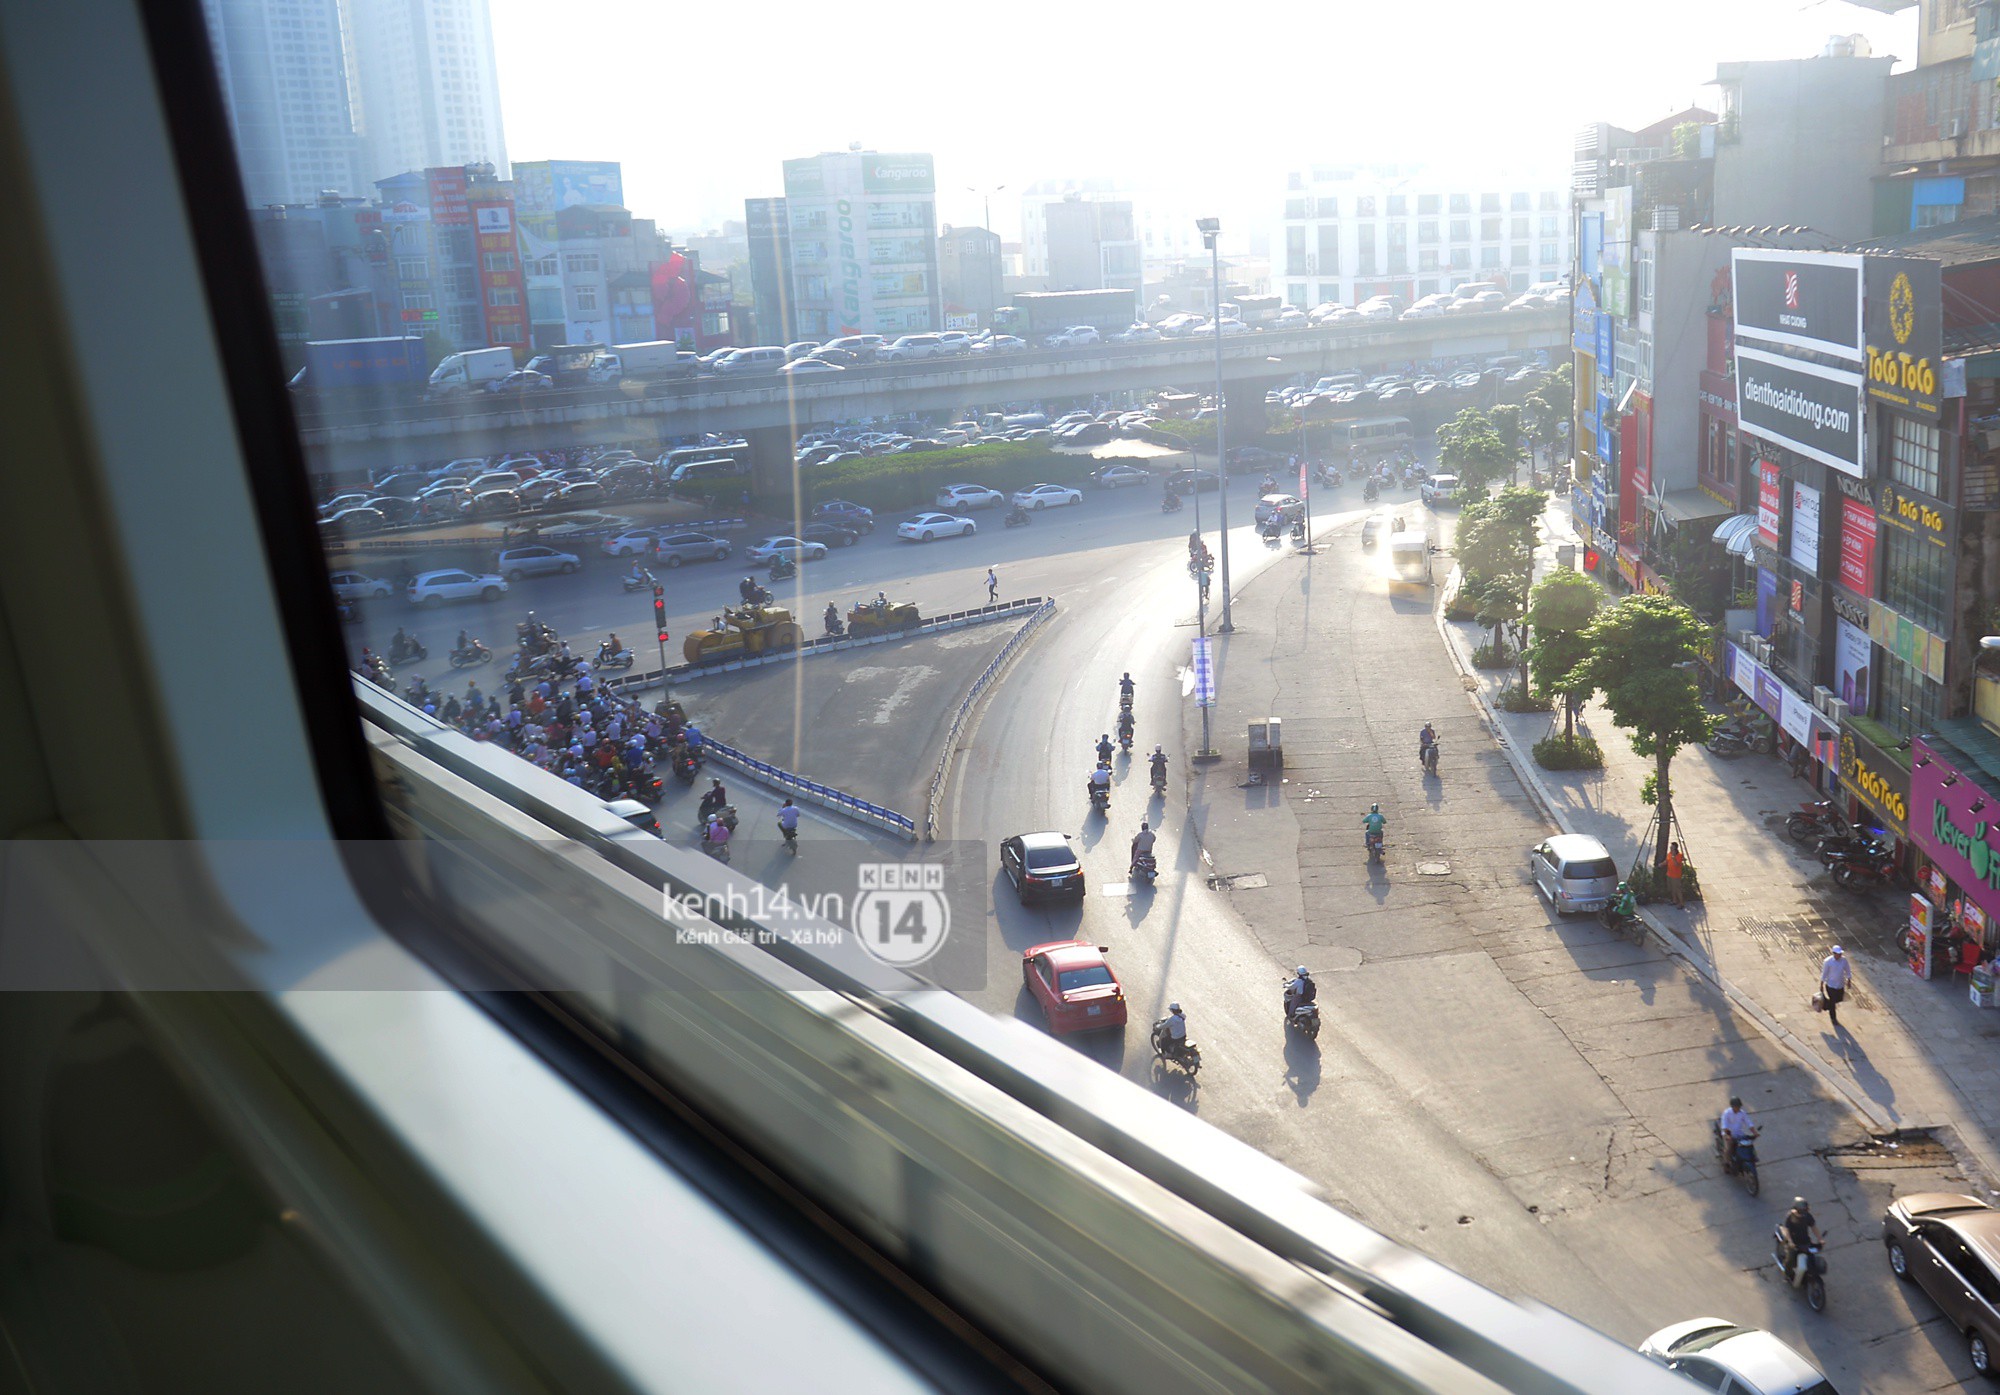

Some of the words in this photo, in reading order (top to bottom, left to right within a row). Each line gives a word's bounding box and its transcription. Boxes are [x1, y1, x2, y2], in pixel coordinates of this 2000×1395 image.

[871, 166, 928, 181] Kangaroo
[837, 199, 862, 337] Kangaroo
[1745, 377, 1849, 433] dienthoaididong.com
[1836, 474, 1874, 507] NOKIA
[1832, 595, 1869, 630] SONY
[1932, 798, 1971, 860] Klever
